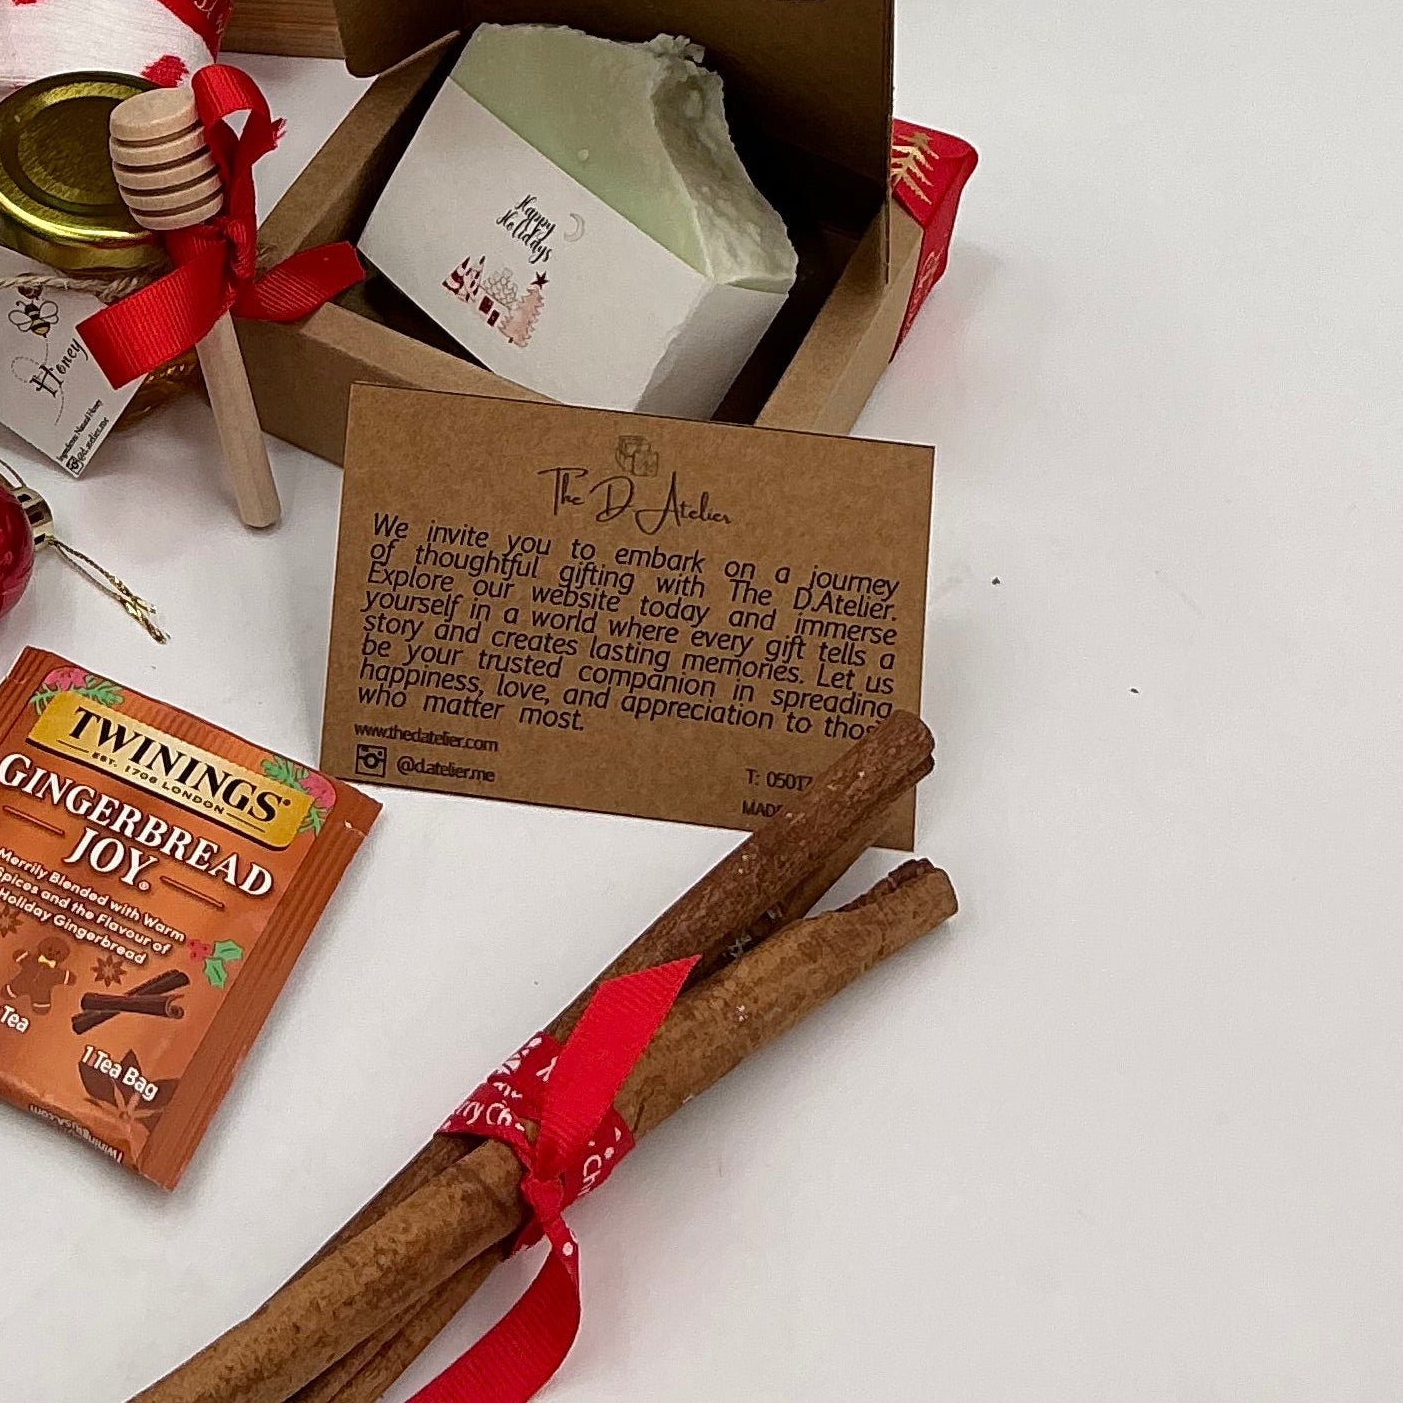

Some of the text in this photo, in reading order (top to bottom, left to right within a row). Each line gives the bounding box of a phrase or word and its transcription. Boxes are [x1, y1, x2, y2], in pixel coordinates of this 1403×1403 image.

[29, 338, 90, 398] Honey
[536, 466, 588, 516] The
[370, 538, 897, 622] of thoughtful gifting with The D.Atelier.
[373, 512, 900, 602] We invite you to embark on a journey
[360, 590, 896, 670] yourself in a world where every gift tells a
[367, 561, 898, 646] Explore our website today and immerse
[361, 633, 391, 658] be
[403, 644, 464, 667] your
[478, 650, 564, 679] trusted
[577, 664, 716, 698] companion
[732, 678, 755, 702] in
[363, 612, 895, 695] story and creates lasting memories. Let us
[357, 683, 585, 732] who matter most.
[359, 659, 485, 697] happiness,
[497, 674, 550, 706] love,
[563, 687, 611, 710] and
[620, 694, 775, 729] appreciation
[785, 713, 813, 734] to
[69, 706, 284, 823] TWININGS
[354, 723, 498, 753] www.thedatelier.com
[162, 780, 225, 815] LONDON
[40, 888, 70, 909] and
[70, 901, 96, 921] the
[96, 913, 151, 946] Flavour
[152, 941, 172, 956] of
[49, 871, 109, 907] Blended
[110, 898, 141, 921] with
[142, 911, 186, 942] Warm
[53, 913, 147, 965] Gingerbread
[0, 1005, 31, 1034] Tea
[93, 1049, 159, 1102] Tea Bag
